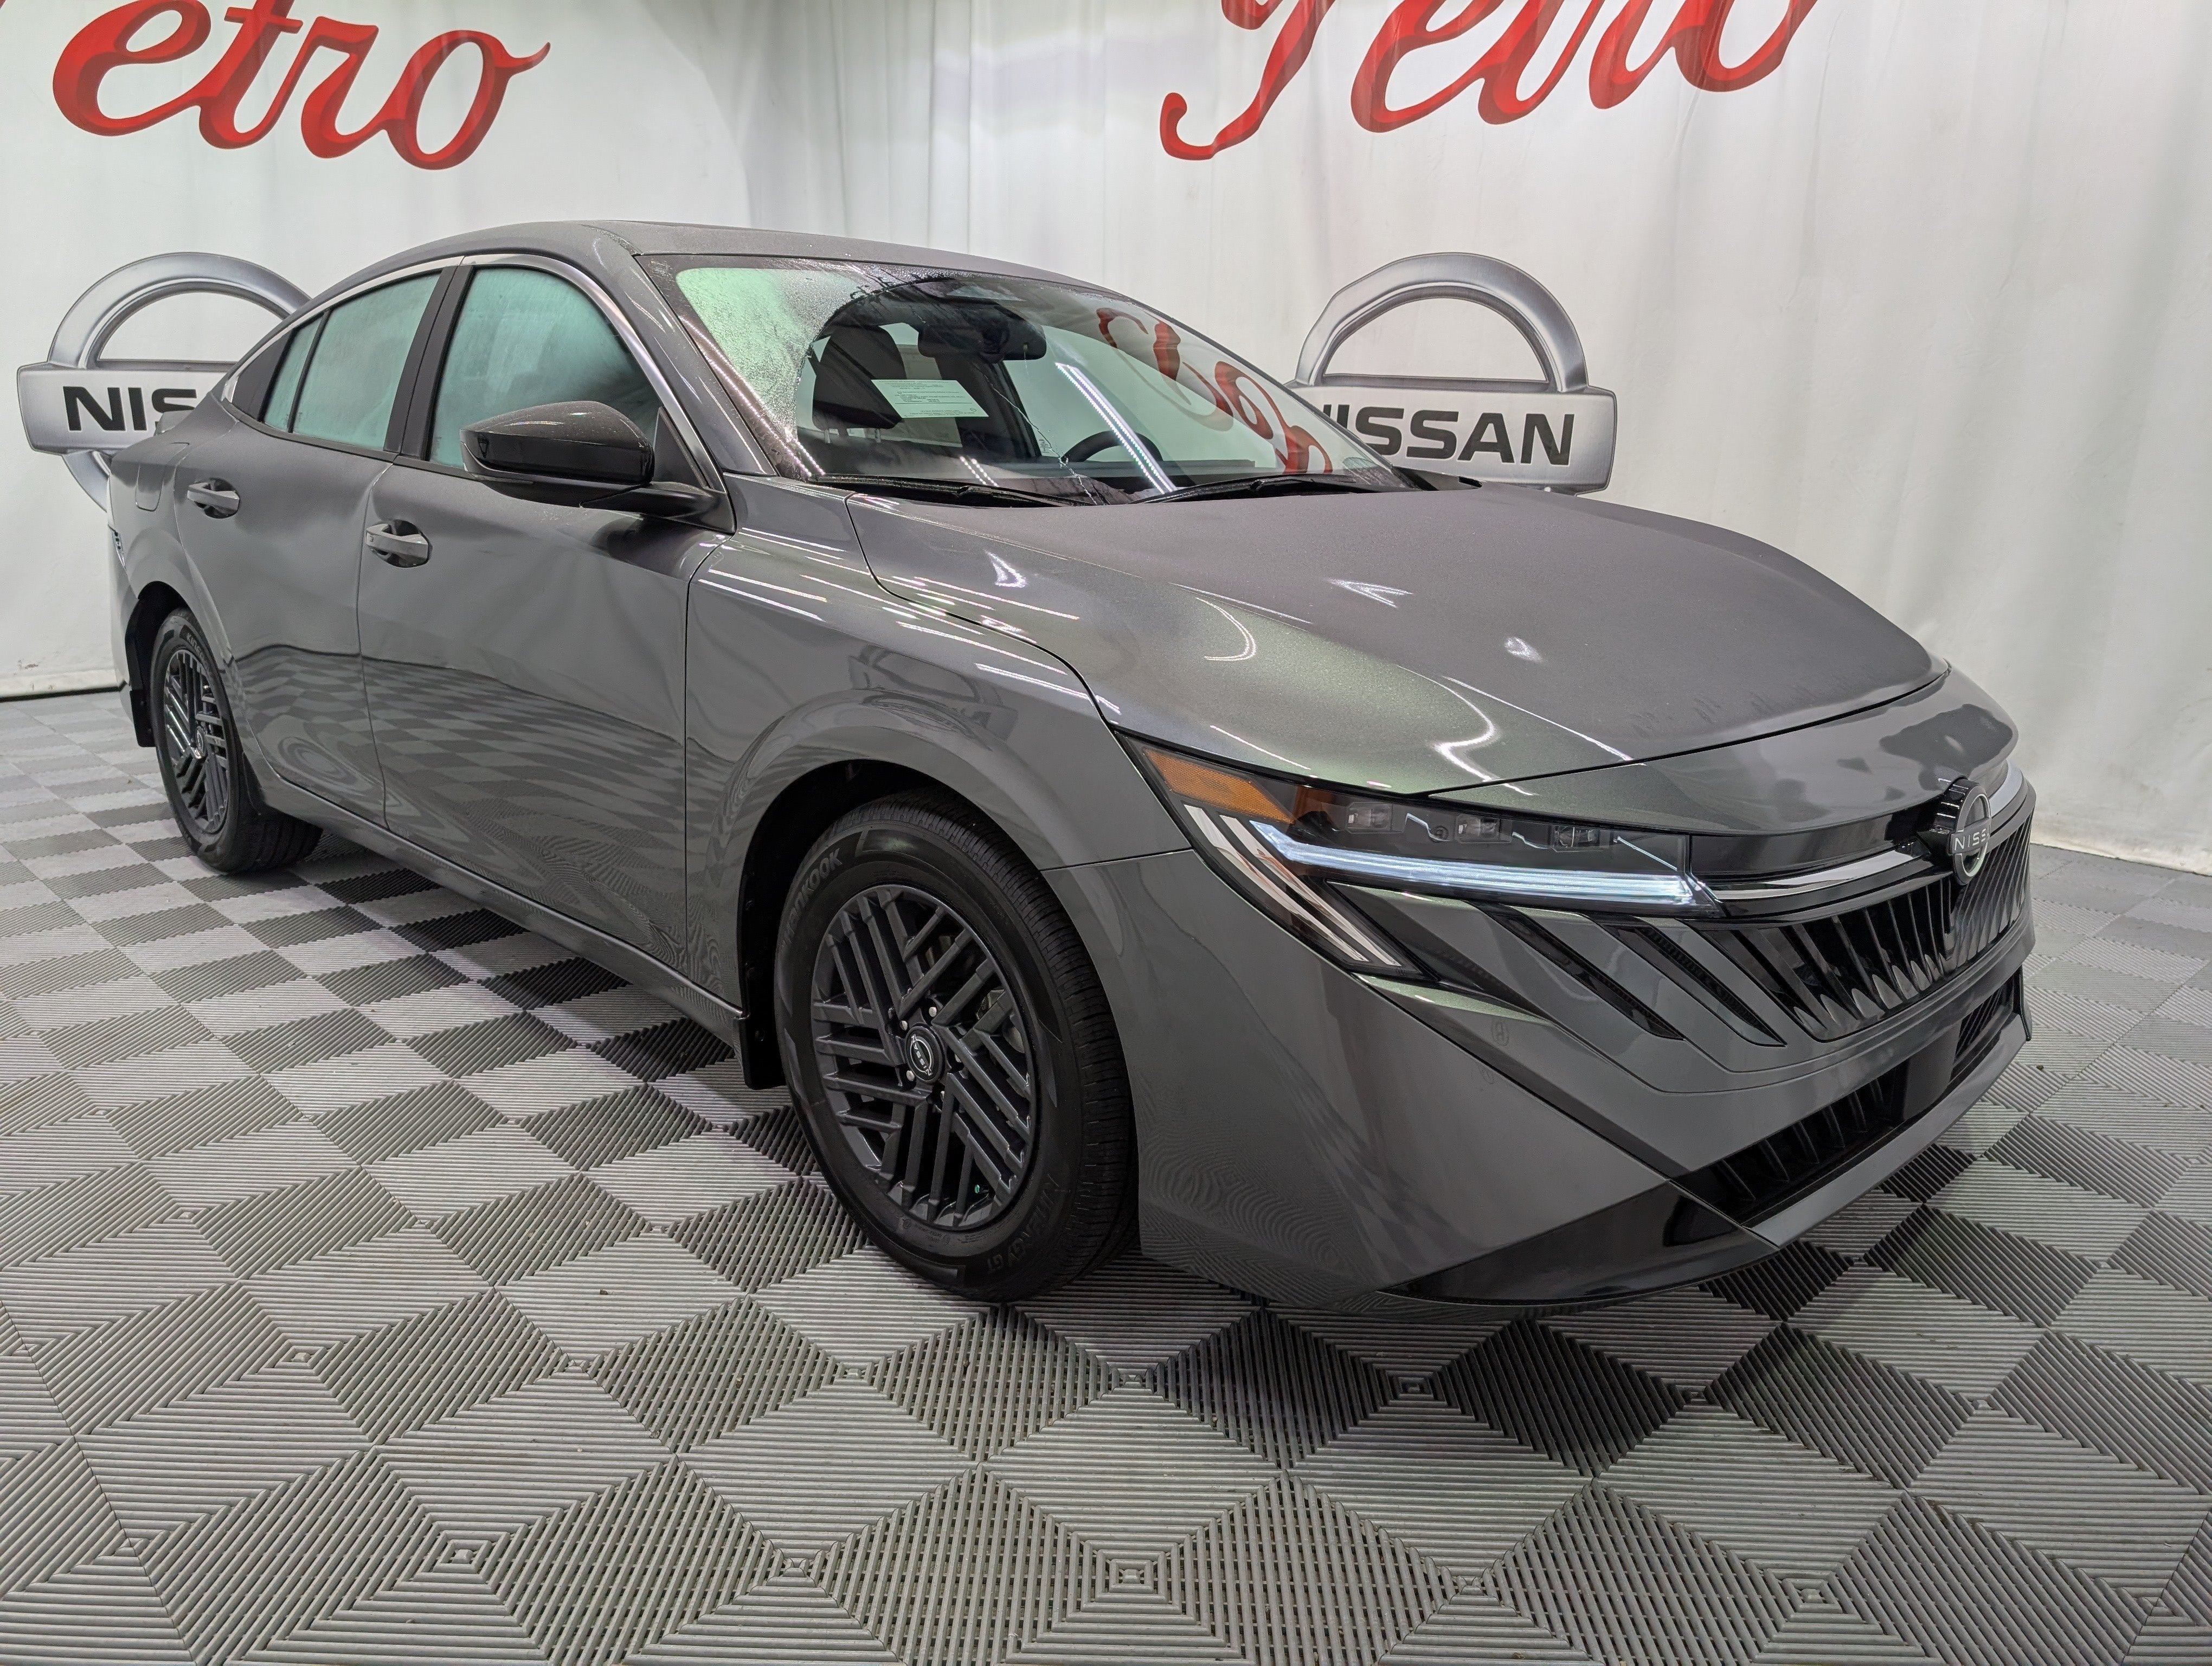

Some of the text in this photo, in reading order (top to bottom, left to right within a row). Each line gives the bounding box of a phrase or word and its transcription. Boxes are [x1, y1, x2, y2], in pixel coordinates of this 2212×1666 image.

[53, 0, 551, 170] etro
[62, 386, 197, 431] NIS
[1323, 403, 1575, 466] SSAN
[1954, 828, 1990, 851] NISS
[911, 1033, 934, 1076] NISSAN
